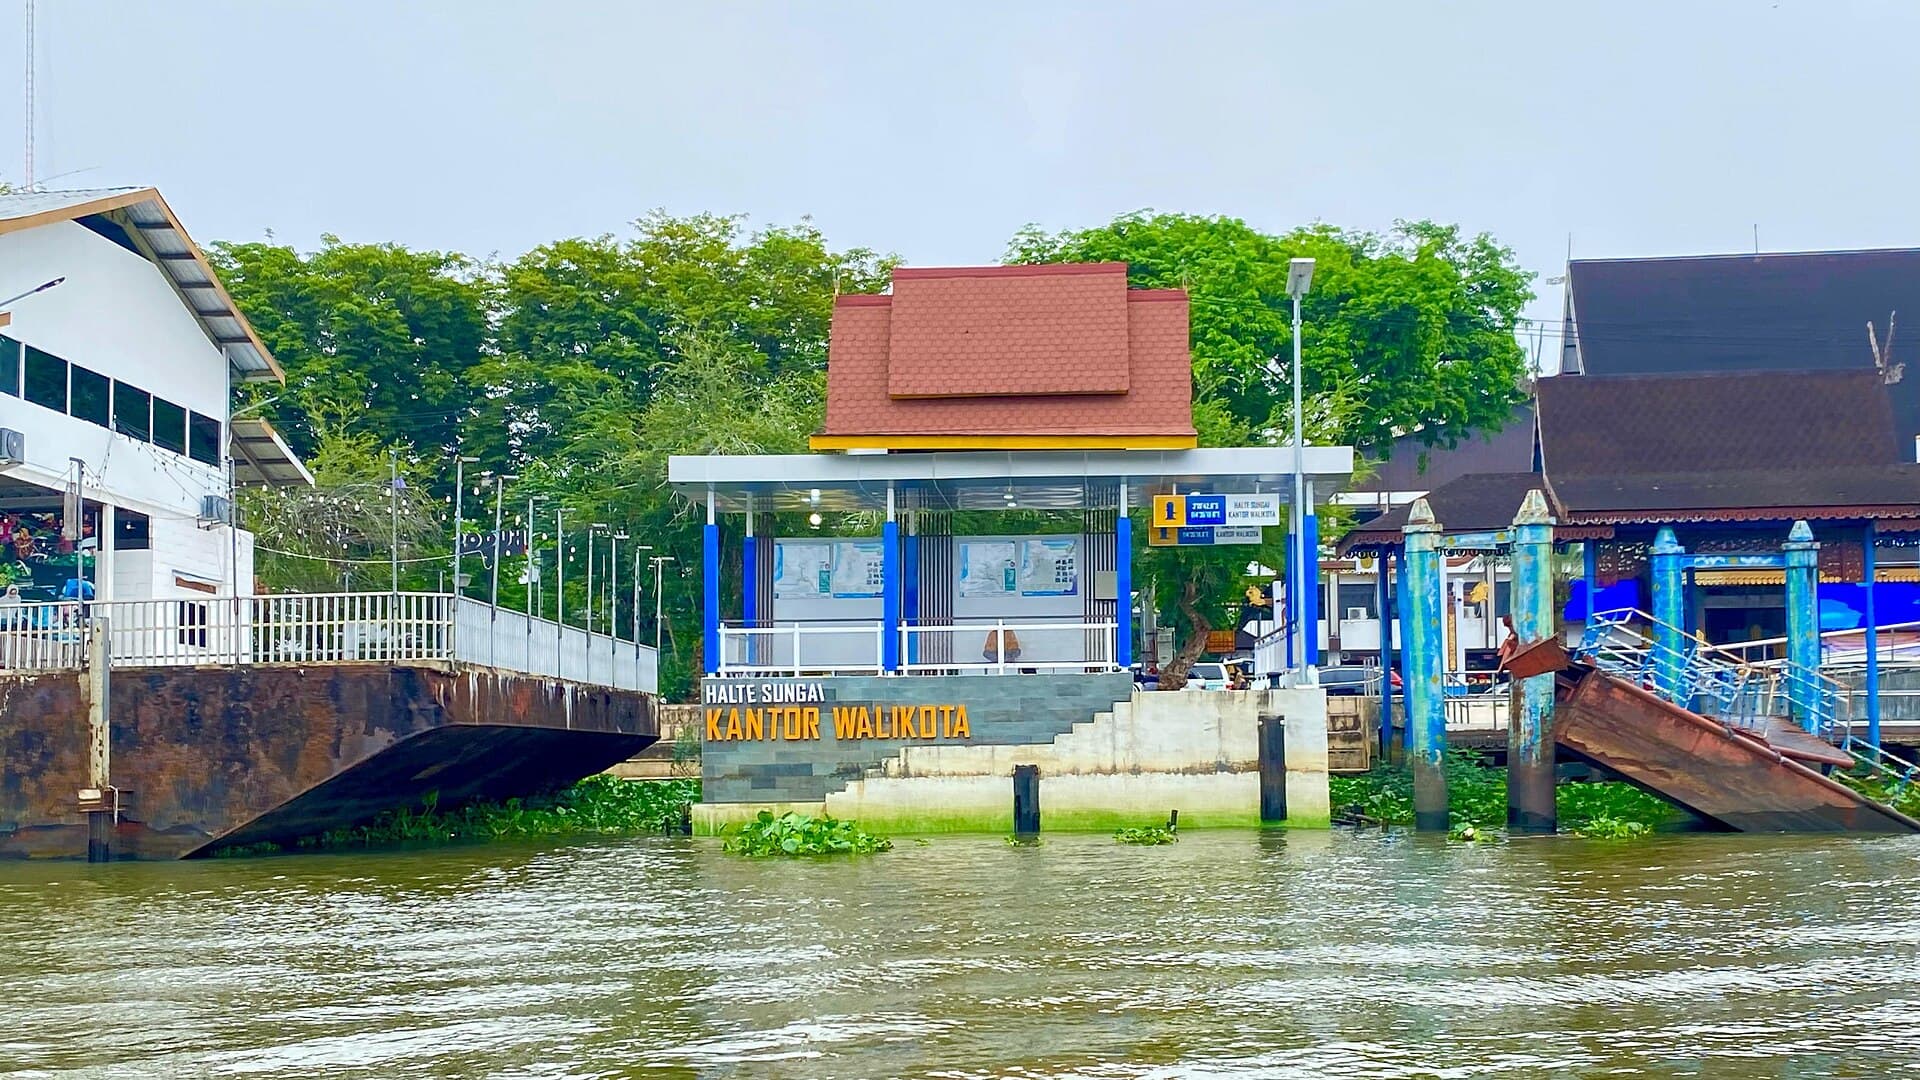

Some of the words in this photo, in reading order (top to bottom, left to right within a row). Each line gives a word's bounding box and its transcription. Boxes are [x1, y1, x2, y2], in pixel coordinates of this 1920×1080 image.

[705, 684, 756, 704] HALTE
[761, 683, 826, 703] SUNGAI
[706, 707, 821, 742] KANTOR
[832, 704, 971, 741] WALIKOTA
